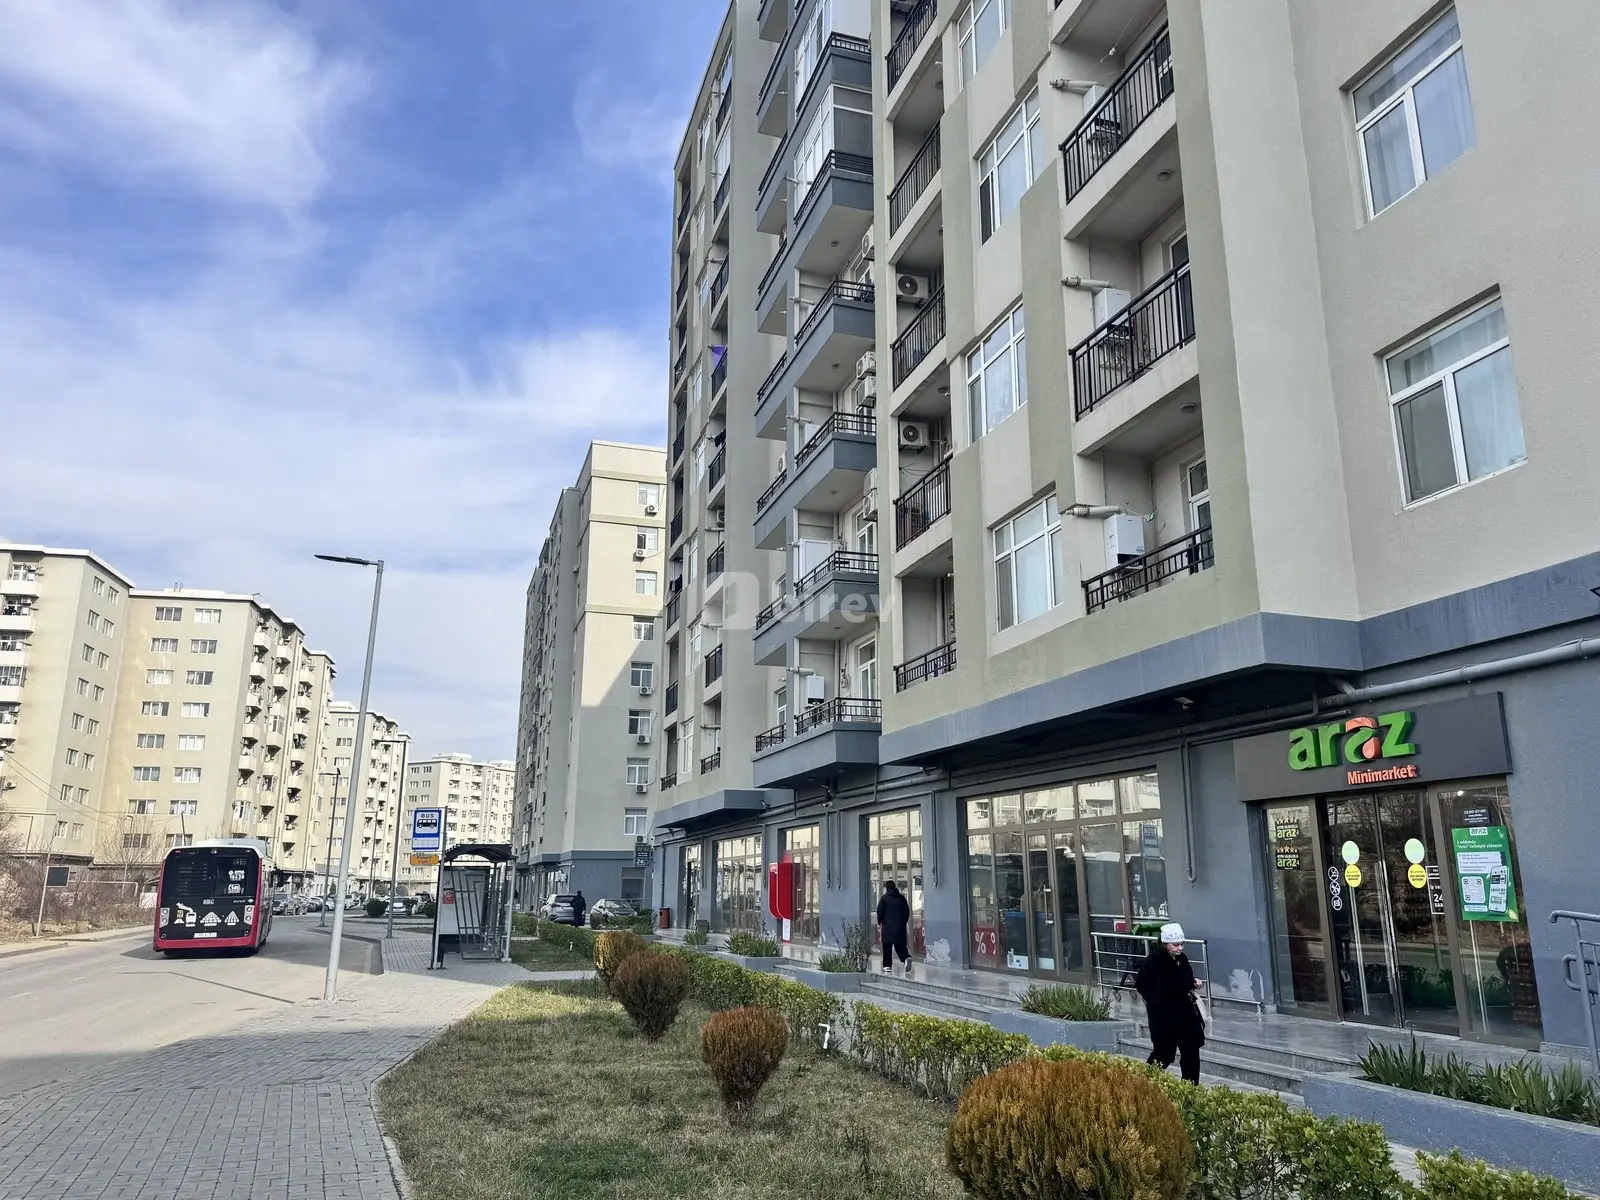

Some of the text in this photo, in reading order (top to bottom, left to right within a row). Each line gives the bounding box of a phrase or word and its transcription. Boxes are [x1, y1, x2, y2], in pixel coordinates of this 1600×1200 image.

[1288, 711, 1416, 771] araz
[1347, 764, 1417, 785] Minimarket
[1277, 829, 1297, 839] araz
[1277, 858, 1297, 867] araz
